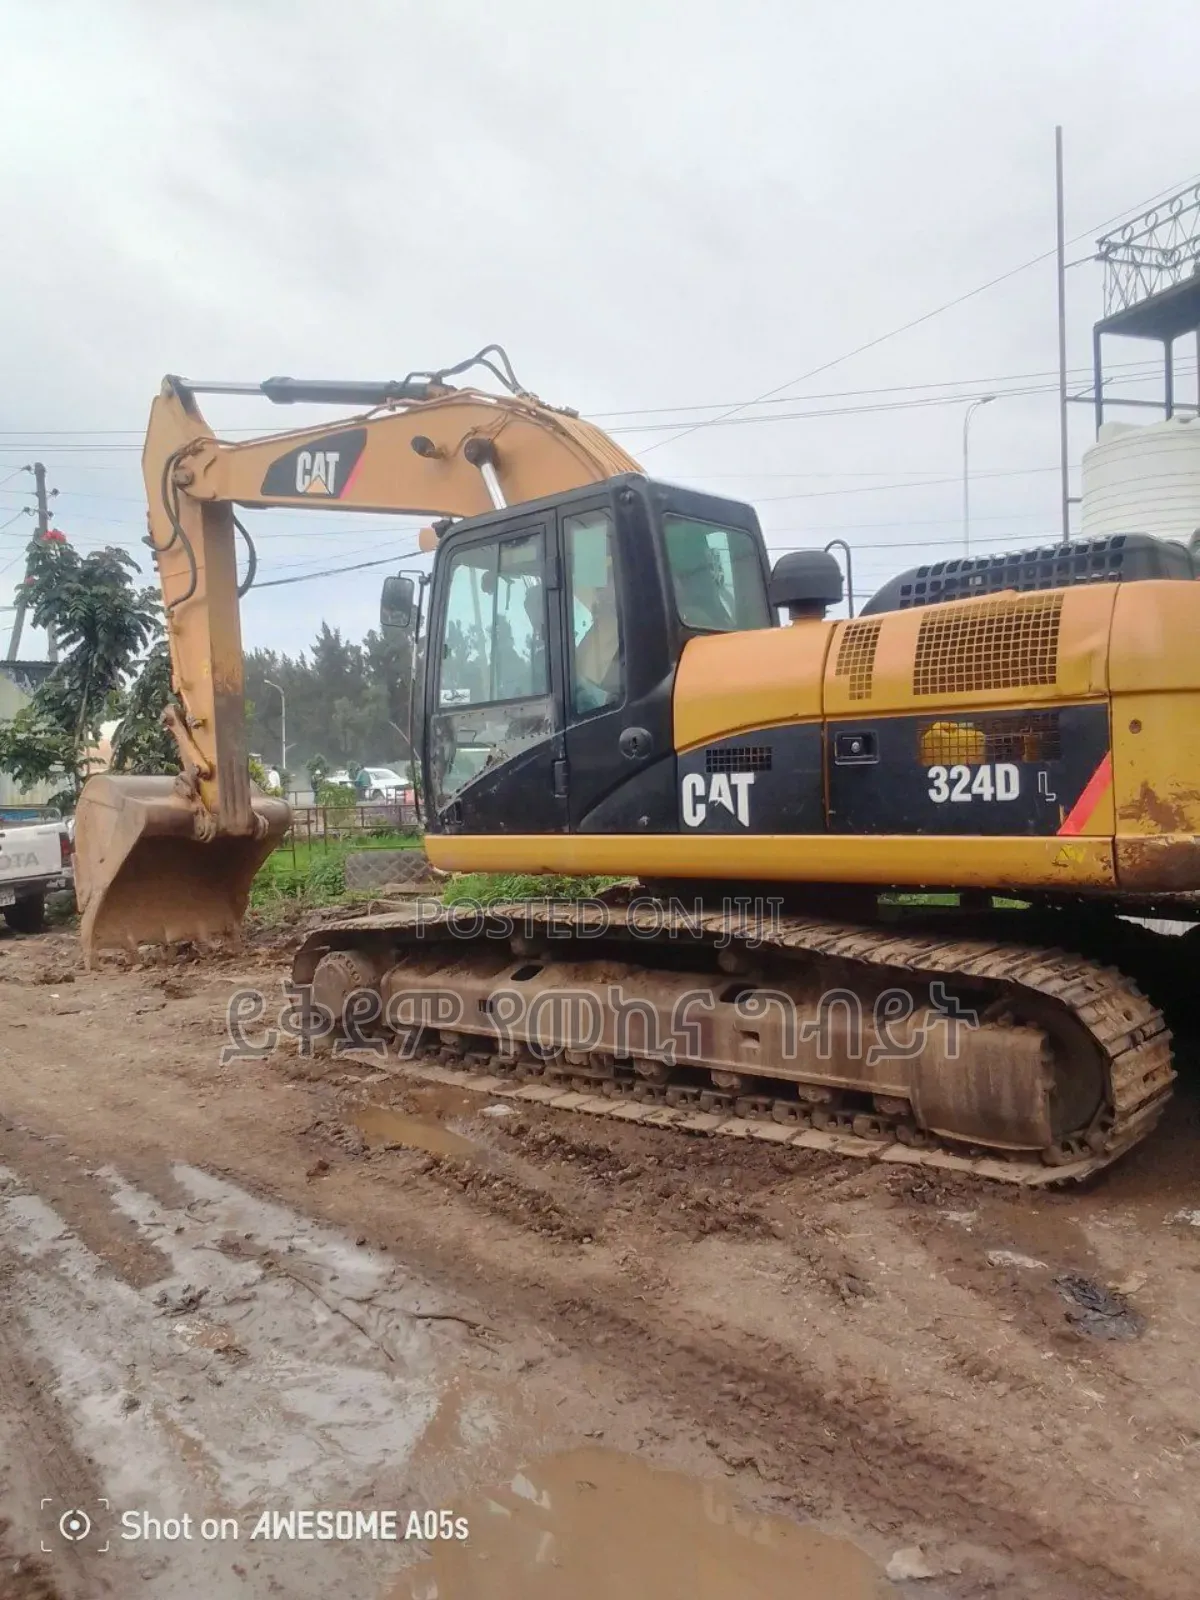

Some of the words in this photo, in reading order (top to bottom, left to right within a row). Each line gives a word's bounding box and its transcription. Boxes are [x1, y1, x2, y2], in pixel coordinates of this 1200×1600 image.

[295, 451, 340, 495] CAT
[682, 772, 754, 827] CAT
[928, 763, 1020, 803] 324D
